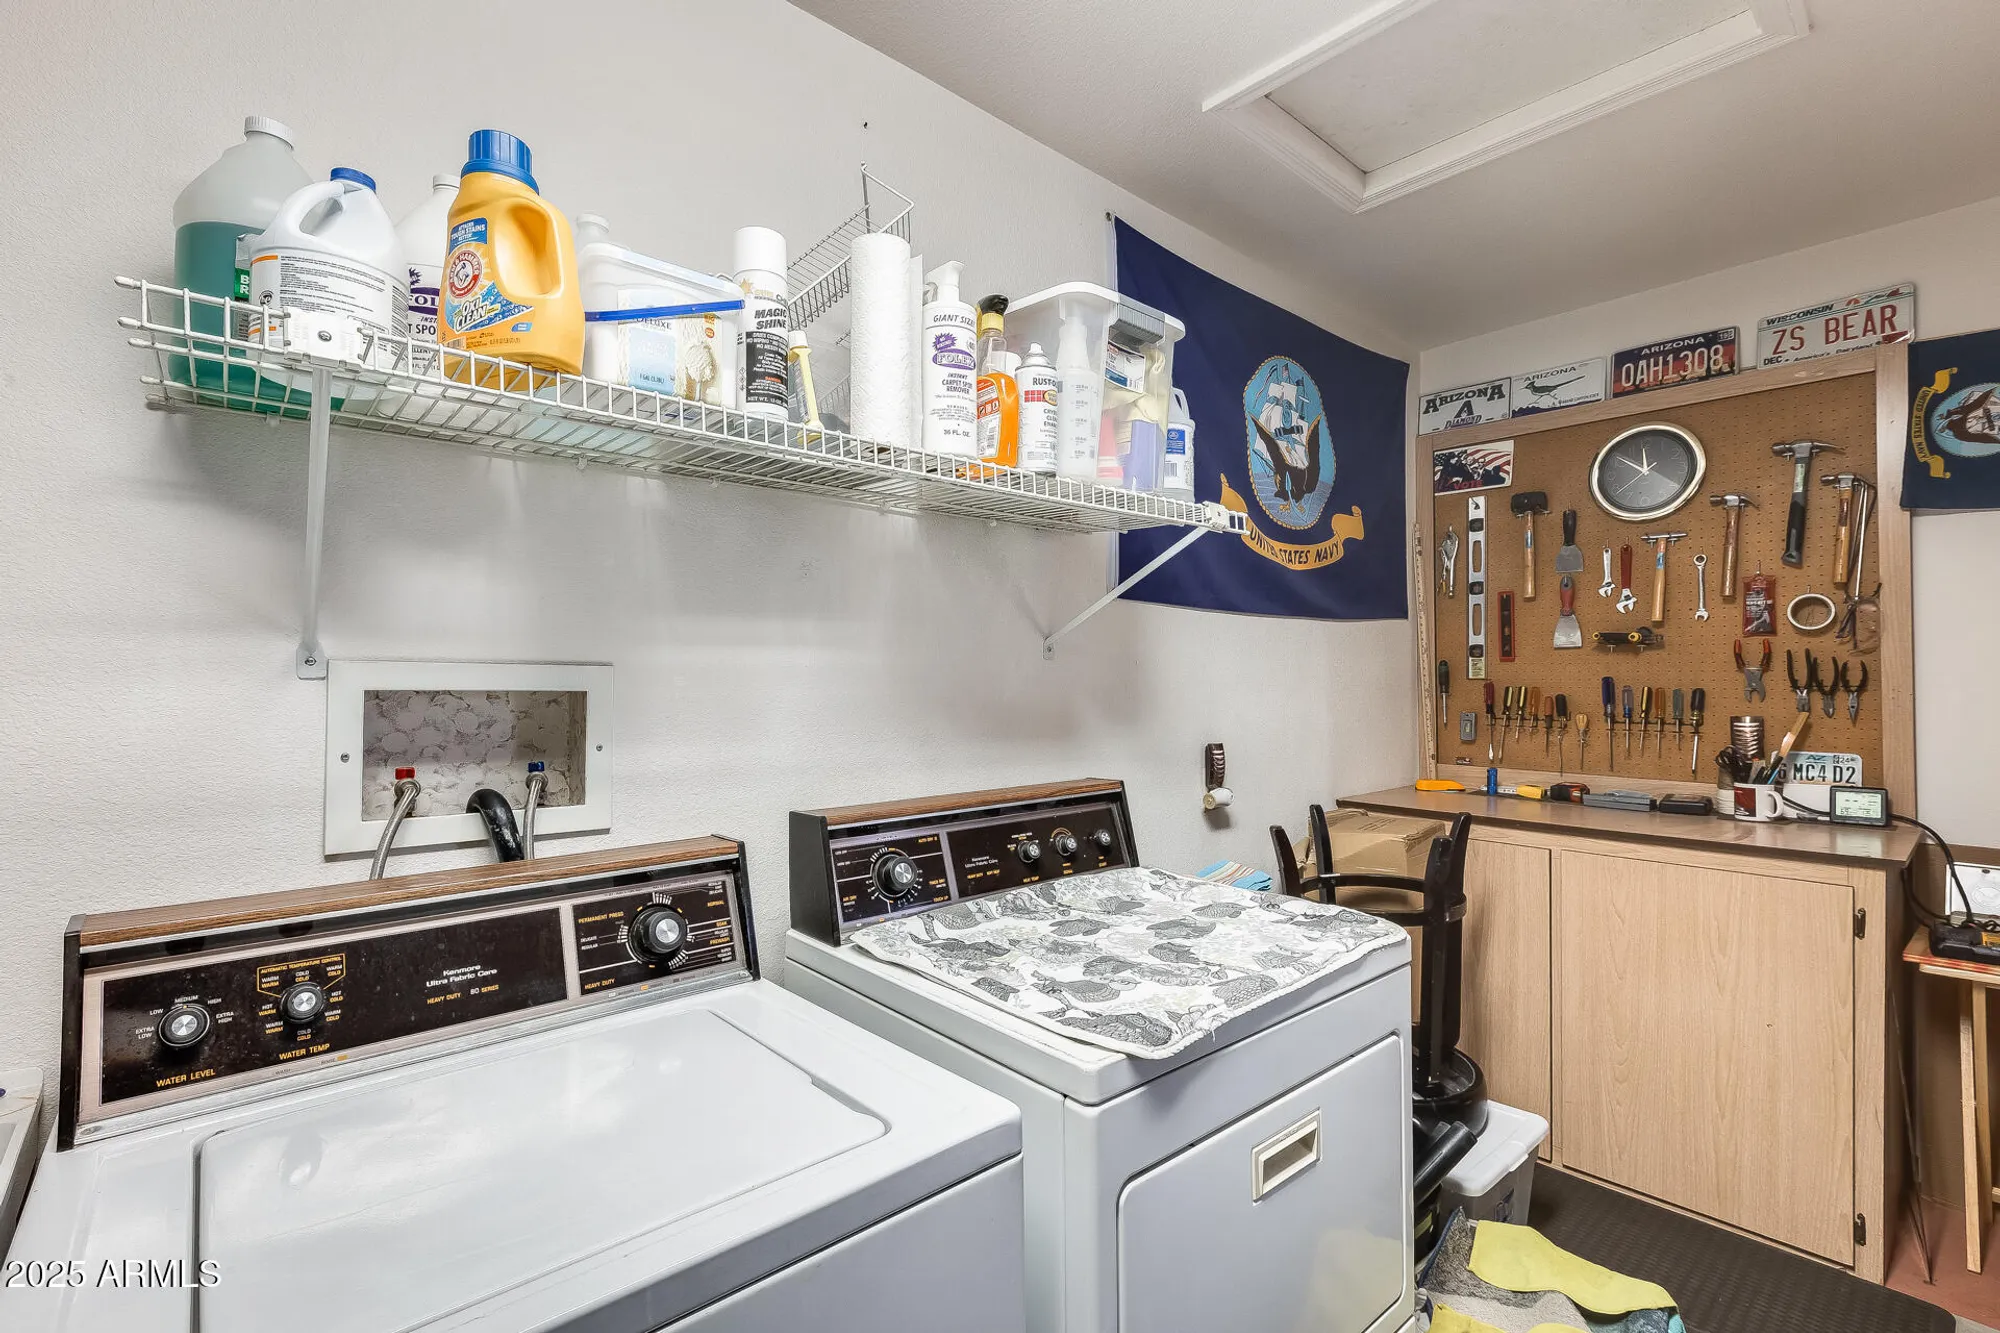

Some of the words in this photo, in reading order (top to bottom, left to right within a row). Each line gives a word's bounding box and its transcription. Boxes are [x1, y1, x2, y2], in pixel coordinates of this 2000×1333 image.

[466, 224, 486, 237] STAINS
[462, 297, 481, 316] OXI
[455, 303, 488, 331] CLEAN
[753, 308, 787, 320] MAGIC
[933, 314, 959, 323] GIANT
[1766, 303, 1834, 326] WISCONSIN
[756, 319, 787, 330] SHINE
[1772, 325, 1805, 356] ZS
[1824, 304, 1898, 346] BEAR
[1640, 336, 1705, 356] ARIZONA
[1763, 356, 1783, 366] DEC
[1523, 366, 1577, 383] ARIZONA
[941, 379, 962, 387] CARPET
[946, 384, 970, 395] REMOVER
[1422, 384, 1506, 415] ARIZONA
[1453, 400, 1475, 419] A
[1444, 414, 1483, 430] DIAMOND
[1453, 480, 1484, 490] VOTE
[1250, 527, 1278, 559] UNITED
[1279, 548, 1310, 565] STATES
[1314, 540, 1340, 564] NAVY
[1792, 763, 1827, 783] MC4
[1832, 765, 1857, 785] D2
[578, 913, 608, 924] PERMANENT
[608, 910, 625, 919] PRESS
[260, 965, 288, 974] AUTOMATIC
[288, 960, 320, 970] TEMPERATURE
[320, 956, 342, 964] CONTROL
[325, 964, 343, 972] WARM
[295, 969, 310, 977] COLD
[327, 969, 341, 977] COLD
[442, 964, 481, 977] Kenmore
[261, 975, 280, 983] WARM
[295, 975, 310, 983] COLD
[425, 979, 448, 988] Ultra
[449, 972, 476, 983] Fabric
[477, 968, 498, 978] Care
[261, 981, 280, 989] WARM
[584, 981, 601, 990] HEAVY
[601, 977, 616, 987] DUTY
[174, 994, 199, 1004] MEDIUM
[207, 997, 222, 1005] HIGH
[329, 995, 344, 1003] COLD
[426, 995, 445, 1005] HEAVY
[446, 992, 462, 1001] DUTY
[149, 1008, 164, 1016] LOW
[215, 1011, 235, 1019] EXTRA
[258, 1008, 277, 1016] WARM
[324, 1009, 342, 1017] WARM
[217, 1016, 233, 1024] HIGH
[325, 1014, 340, 1022] COLD
[265, 1020, 284, 1029] WARM
[135, 1026, 155, 1035] EXTRA
[265, 1026, 284, 1035] WARM
[138, 1032, 153, 1040] LOW
[296, 1033, 312, 1041] COLD
[278, 1048, 307, 1060] WATER
[308, 1043, 331, 1054] TEMP
[155, 1074, 187, 1088] WATER
[190, 1068, 216, 1080] LEVEL
